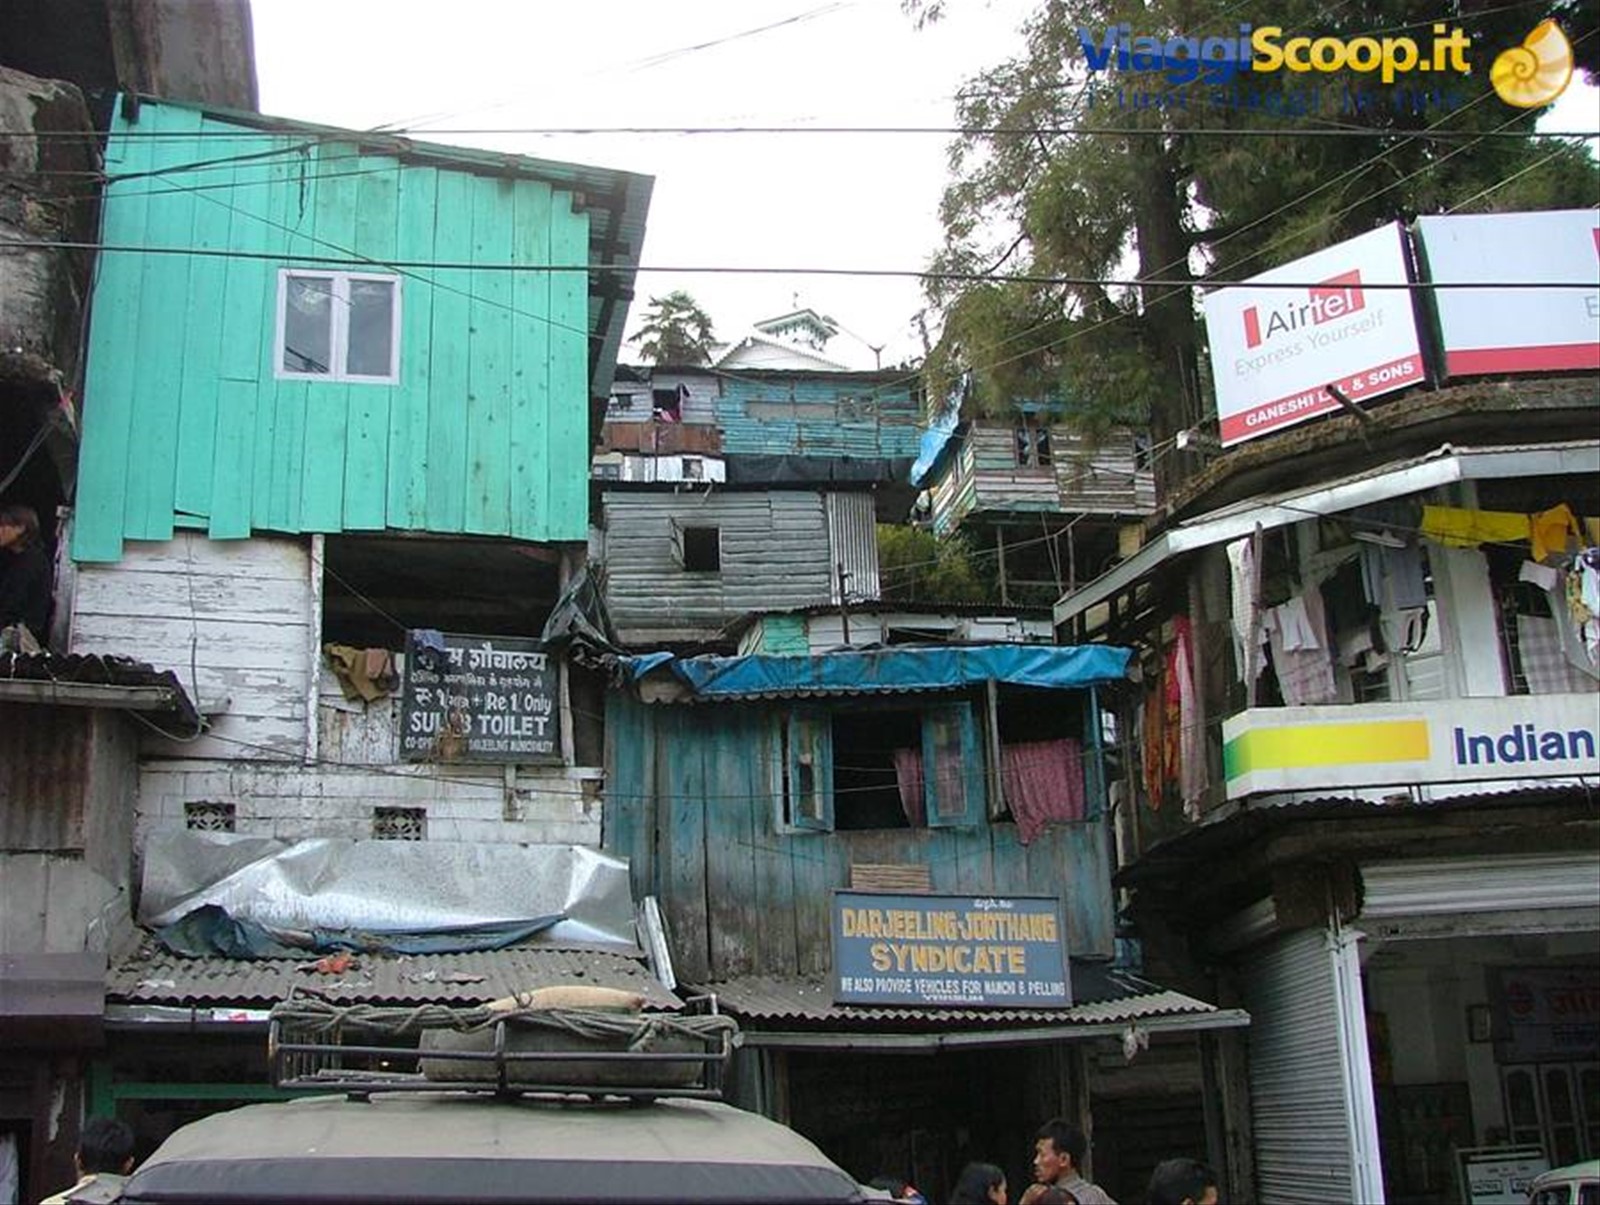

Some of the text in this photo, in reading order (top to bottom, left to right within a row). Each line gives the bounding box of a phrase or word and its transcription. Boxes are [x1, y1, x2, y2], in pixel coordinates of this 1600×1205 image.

[1267, 284, 1355, 339] Airtel
[1234, 309, 1387, 378] Express Yourself
[1245, 360, 1415, 428] GANESHI LL & SONS
[469, 641, 548, 671] शौचालय
[487, 692, 508, 710] Re
[524, 693, 552, 716] Only
[411, 711, 549, 737] SULB TOILET
[1454, 724, 1595, 765] Indian
[870, 941, 1026, 974] SYNDICATE
[841, 977, 853, 992] WE
[854, 977, 874, 993] ALSO
[875, 978, 912, 994] PROVIDE
[914, 979, 960, 995] VEHICLES
[961, 980, 982, 995] FOR
[1028, 982, 1065, 997] PELLING
